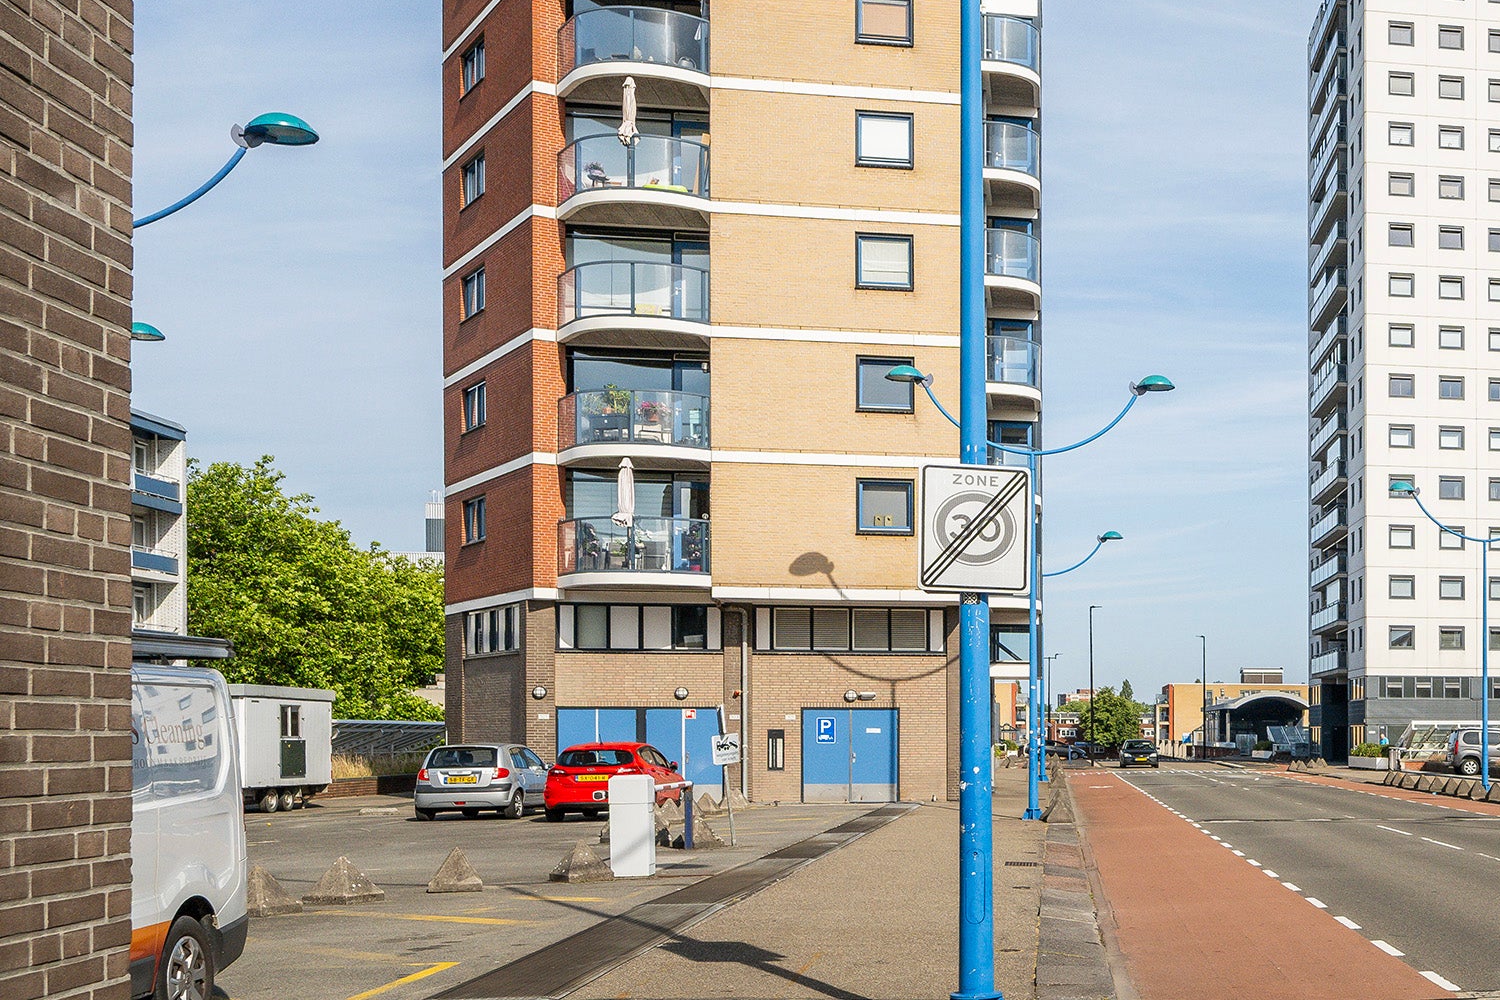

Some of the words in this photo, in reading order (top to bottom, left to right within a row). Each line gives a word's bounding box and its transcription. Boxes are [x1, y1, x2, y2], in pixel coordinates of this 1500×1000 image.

[952, 473, 1000, 487] ZONE
[949, 513, 1002, 543] 30
[143, 715, 206, 750] Cleaning
[820, 719, 832, 733] P
